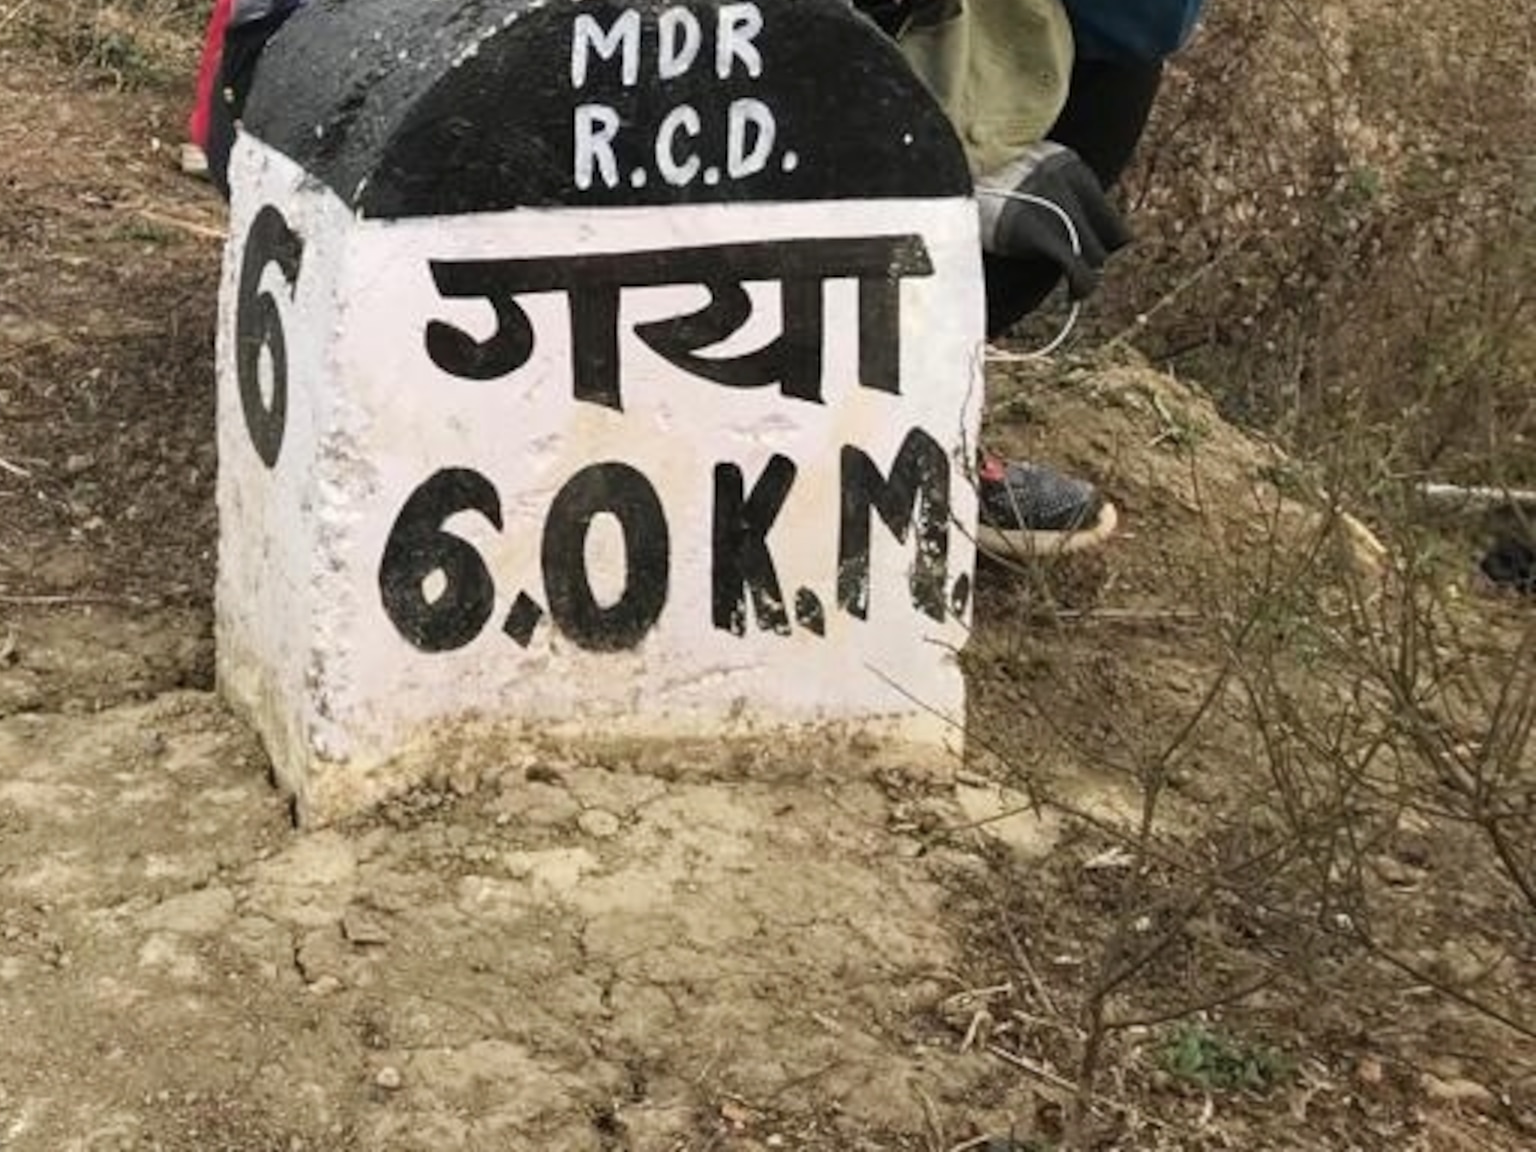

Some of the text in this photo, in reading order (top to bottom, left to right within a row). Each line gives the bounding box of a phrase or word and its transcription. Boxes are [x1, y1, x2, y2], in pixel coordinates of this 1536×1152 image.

[571, 2, 763, 88] MDR
[573, 98, 799, 190] R.C.D.
[236, 204, 304, 469] 6
[424, 233, 935, 412] गया
[378, 426, 970, 653] 6.0 K.M.
